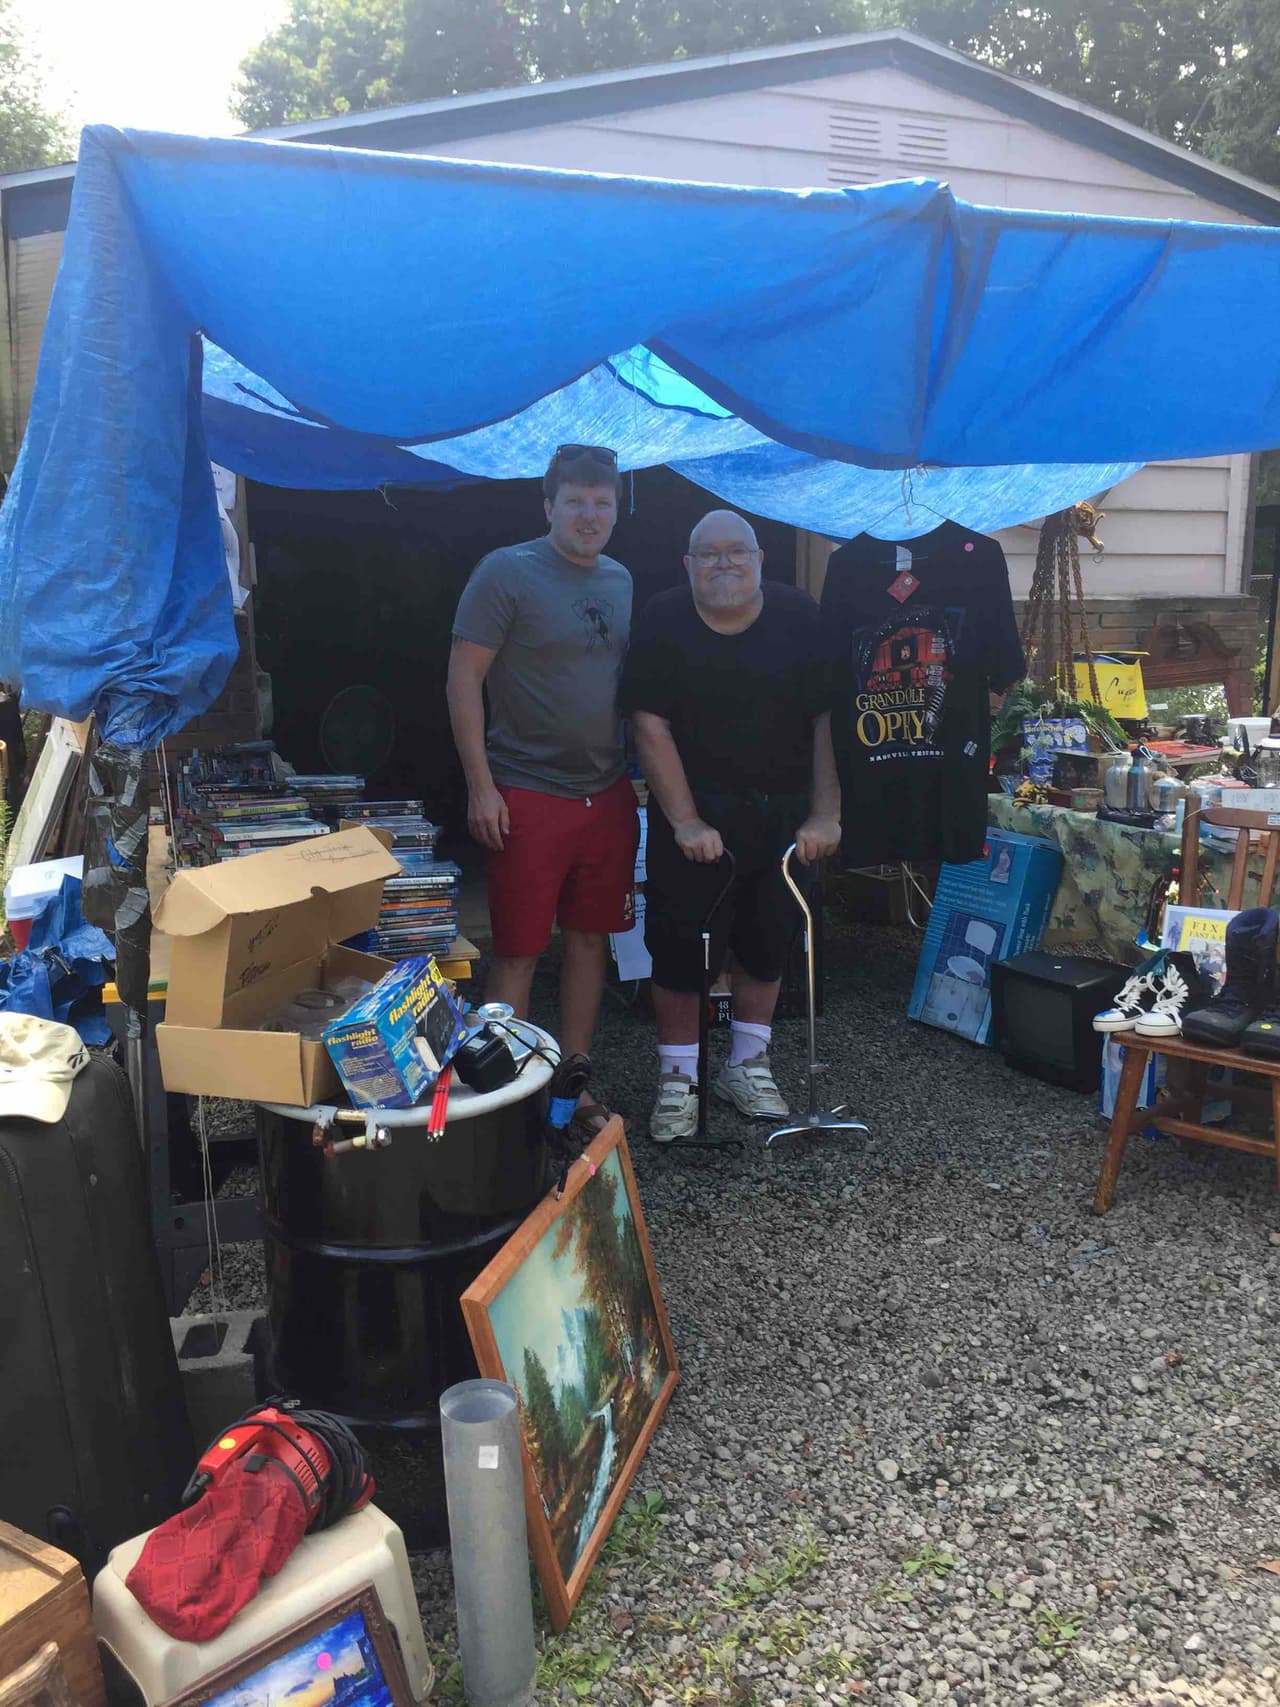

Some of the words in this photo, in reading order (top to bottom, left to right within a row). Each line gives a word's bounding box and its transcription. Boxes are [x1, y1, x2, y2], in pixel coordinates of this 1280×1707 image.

[856, 689, 905, 711] GRAND
[389, 974, 432, 1025] flashlight
[412, 987, 435, 1017] radio
[327, 1028, 376, 1046] flashlight
[351, 1035, 378, 1047] radio
